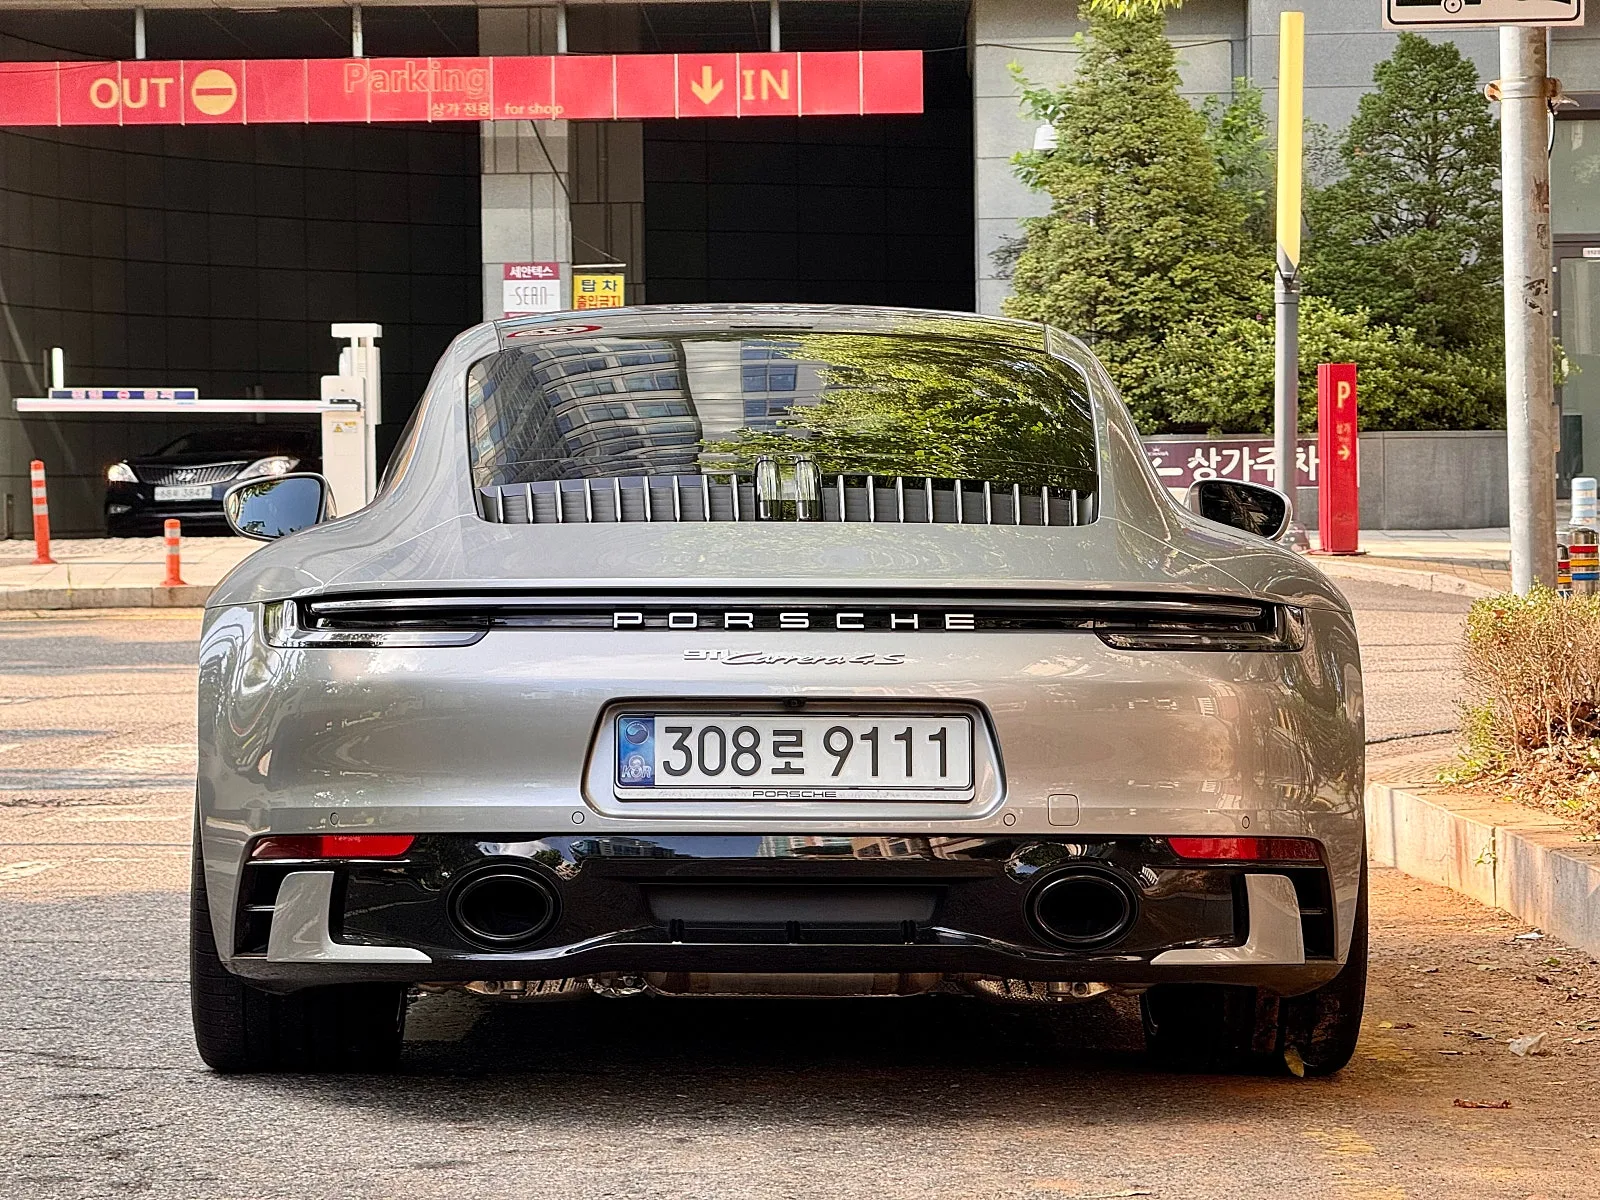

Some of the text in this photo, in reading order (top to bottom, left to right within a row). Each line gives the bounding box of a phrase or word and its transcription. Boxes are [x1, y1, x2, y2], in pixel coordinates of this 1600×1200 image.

[343, 60, 490, 100] Parking
[742, 68, 790, 101] IN
[89, 77, 174, 109] OUT
[432, 103, 565, 117] 상가 전용 for shop
[509, 265, 554, 278] 세안텍스
[575, 295, 621, 310] 출입금지
[1337, 381, 1351, 409] P
[613, 612, 975, 630] PORSCHE
[683, 648, 729, 661] 911
[722, 651, 846, 666] Carrera
[662, 725, 948, 778] 308로 9111
[621, 765, 652, 779] KOR
